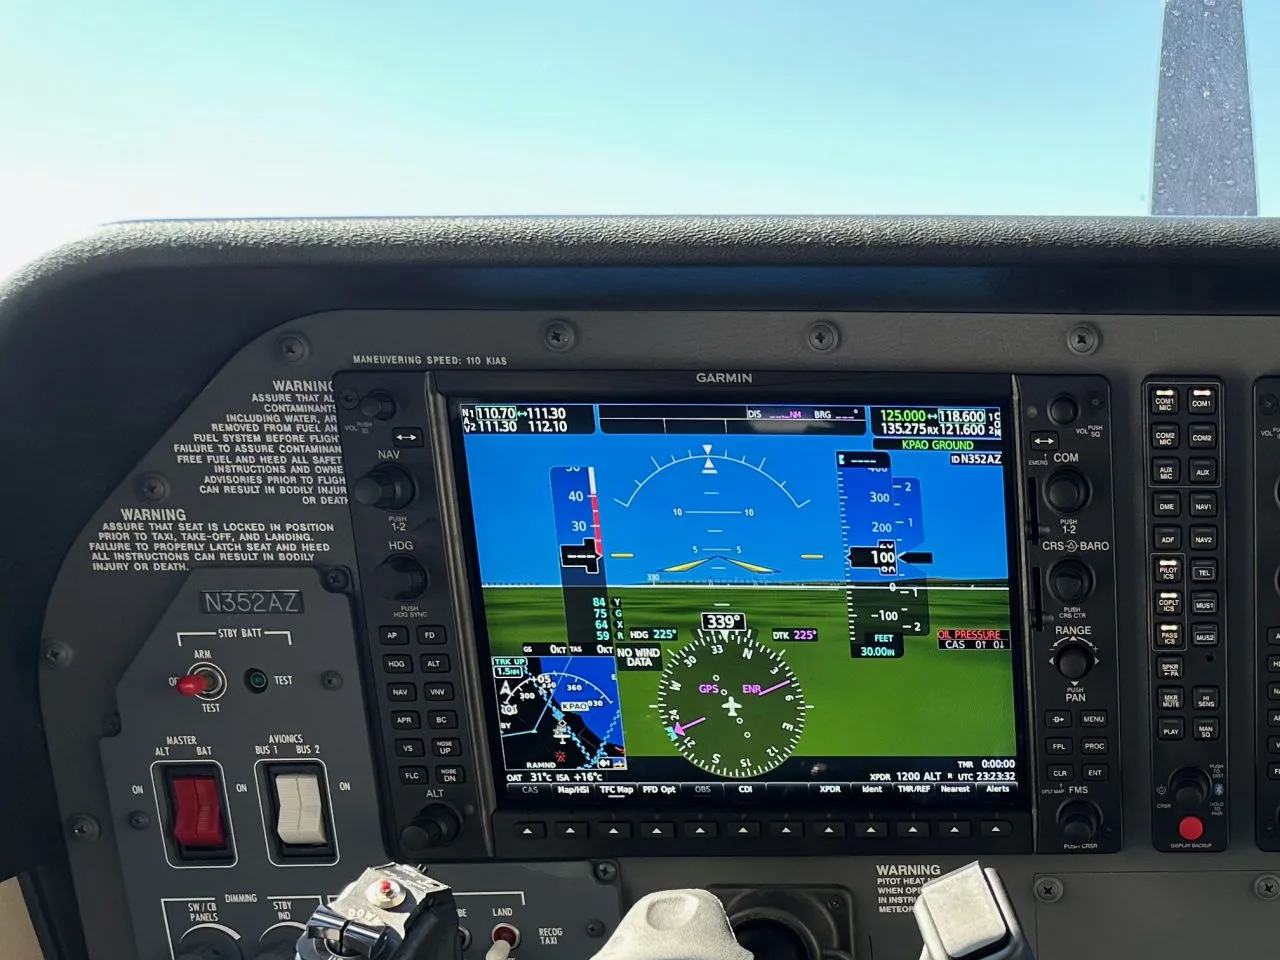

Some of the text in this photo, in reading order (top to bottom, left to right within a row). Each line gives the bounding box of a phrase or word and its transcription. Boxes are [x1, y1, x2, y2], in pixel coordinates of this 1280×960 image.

[353, 355, 508, 366] MANEUVERING SPEED: 110 KIAS
[696, 372, 752, 383] GARMIN
[478, 408, 566, 419] 110.70 111.30
[880, 410, 984, 422] 125.000 118.600
[479, 421, 568, 432] 111.30 112.10
[882, 423, 985, 435] 135.275 121.600
[902, 440, 974, 450] KPAO GROUND
[378, 450, 400, 460] NAV
[1054, 453, 1078, 462] COM
[121, 508, 186, 521] WARNING
[103, 522, 334, 532] ASSURE THAT SEAT IS LOCKED IN POSITION
[389, 541, 413, 550] HDG
[93, 562, 189, 572] INJURY OR DEATH.
[206, 593, 300, 612] N352AZ
[707, 615, 740, 628] 339°
[218, 628, 262, 638] STBY BATT
[630, 629, 676, 640] HDG 225°
[773, 630, 816, 640] DTK 225°
[938, 630, 1000, 640] OIL PRESSURE
[1055, 626, 1092, 635] RANGE
[617, 648, 660, 658] NO WIND
[628, 658, 652, 667] DATA
[274, 676, 292, 684] TEST
[202, 704, 220, 712] TEST
[167, 736, 197, 745] MASTER
[269, 734, 302, 744] AVIONICS
[256, 745, 270, 754] BUS
[296, 744, 311, 754] BUS
[958, 760, 1015, 769] TMR 0:00:00
[870, 771, 942, 782] XPDR 1200 ALT
[958, 771, 1016, 781] UTC 23:23:32
[600, 785, 633, 796] TFC Map
[941, 784, 970, 794] Nearest
[986, 784, 1010, 792] Alerts
[876, 865, 940, 875] WARNING
[225, 894, 258, 902] DIMMING
[190, 913, 218, 922] PANELS
[539, 928, 562, 936] RECOG
